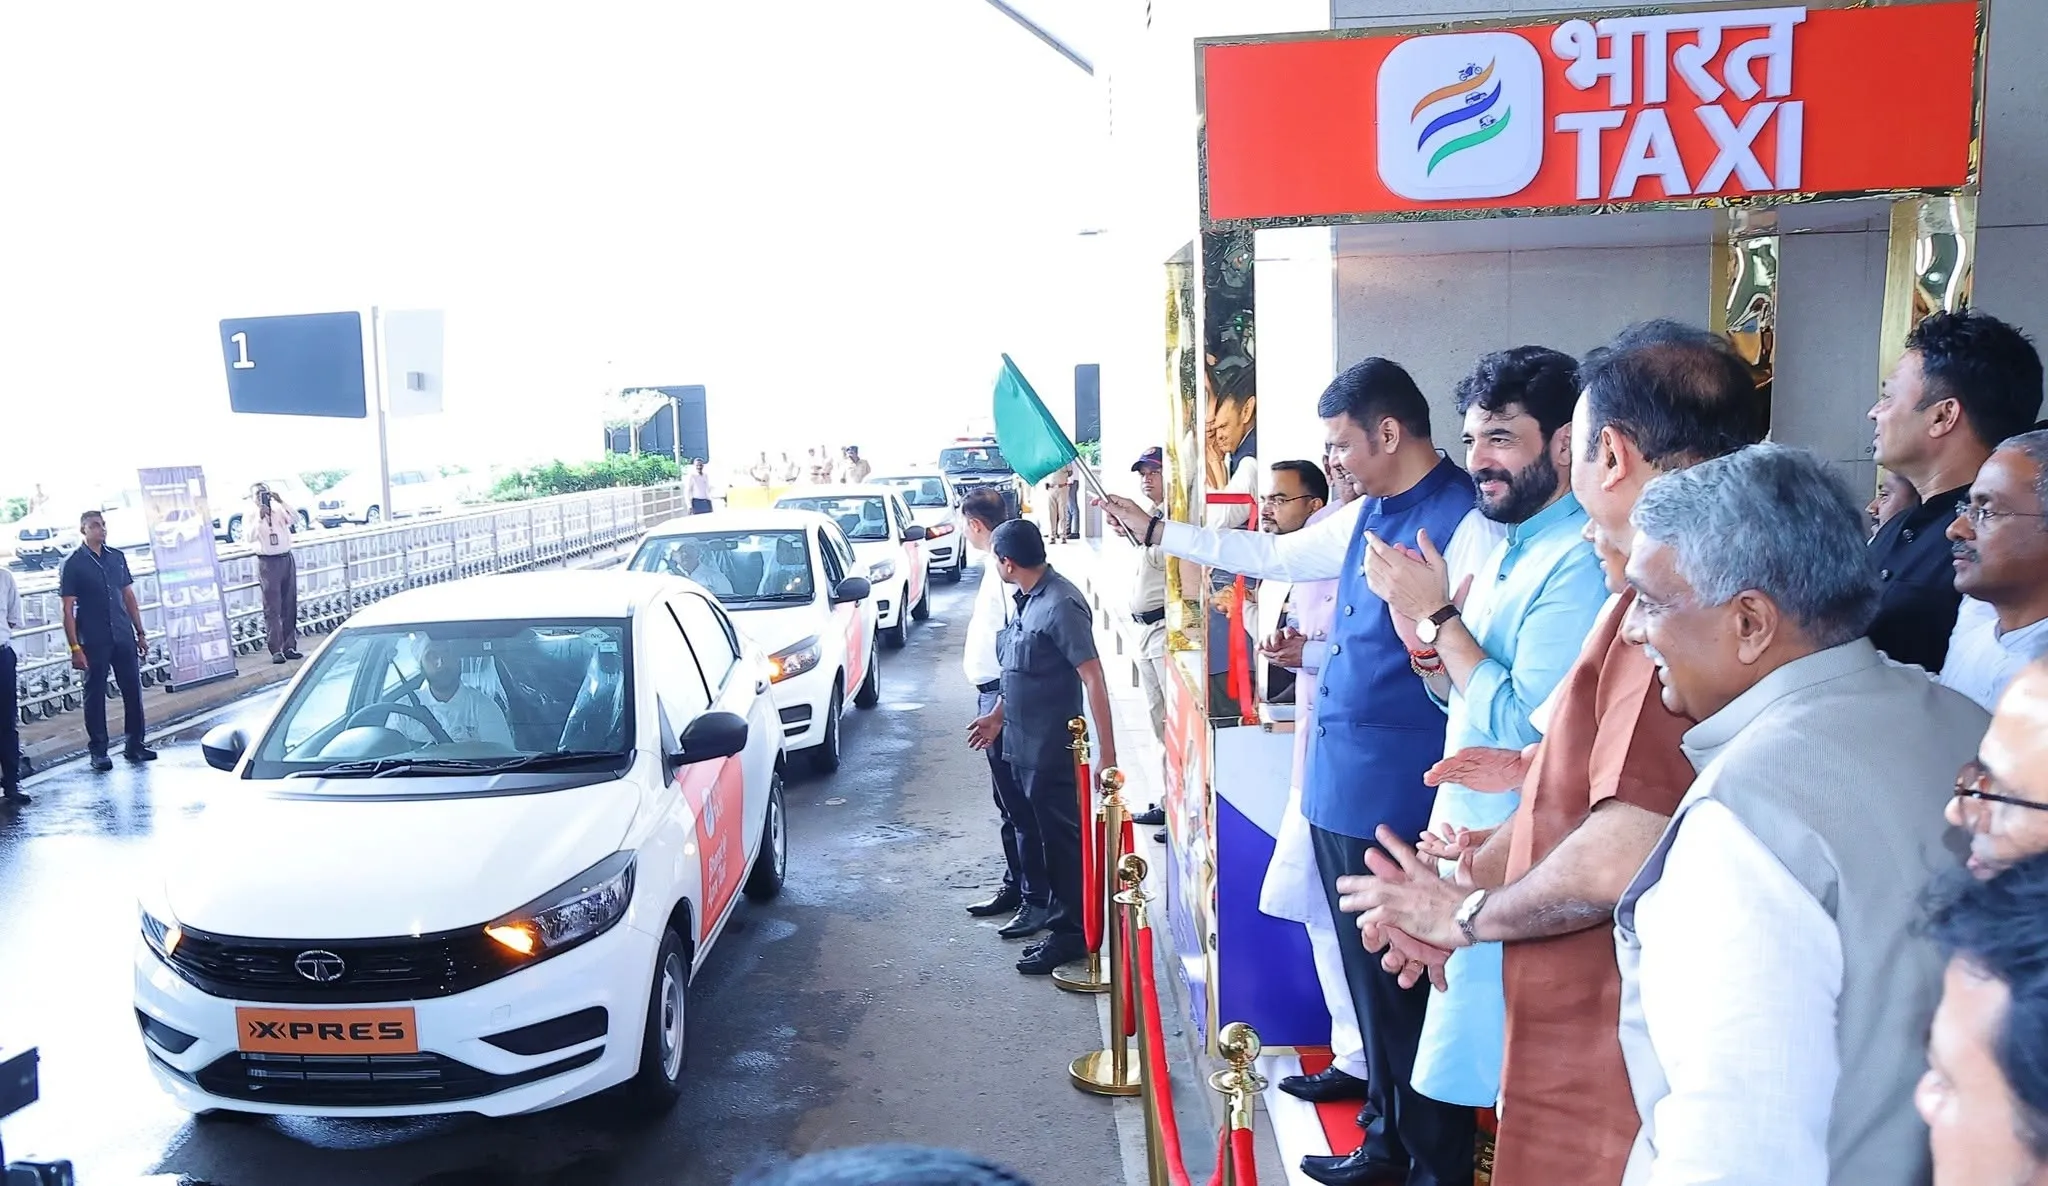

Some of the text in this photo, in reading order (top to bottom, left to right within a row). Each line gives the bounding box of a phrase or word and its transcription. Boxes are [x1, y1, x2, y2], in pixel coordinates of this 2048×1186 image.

[1551, 6, 1806, 106] भारत
[1554, 101, 1803, 200] TAXI
[230, 331, 256, 369] 1
[249, 1021, 404, 1040] XPRES
